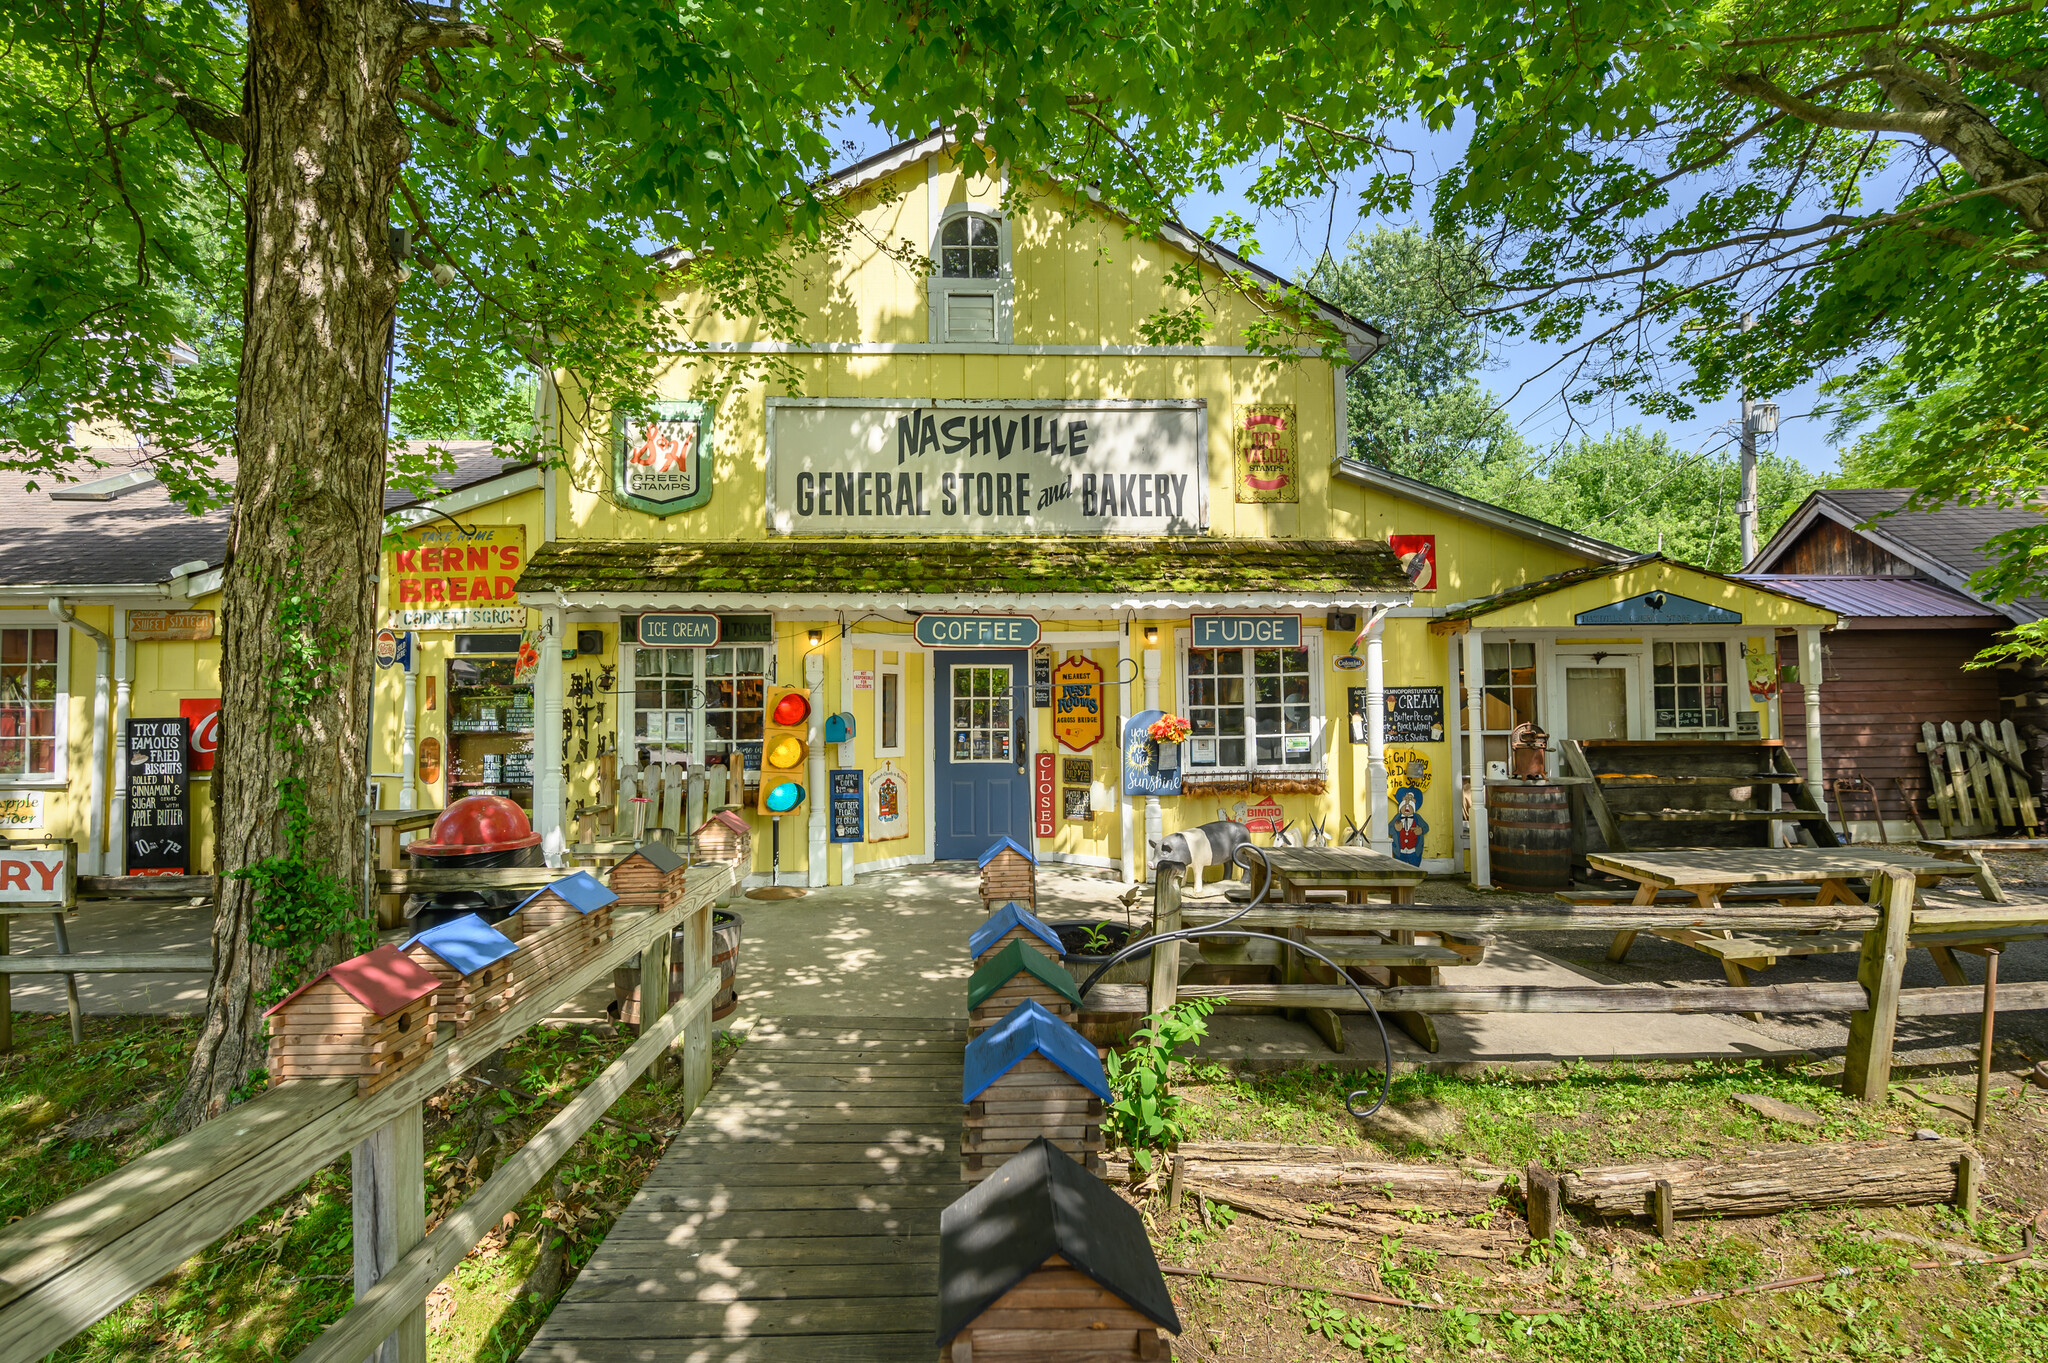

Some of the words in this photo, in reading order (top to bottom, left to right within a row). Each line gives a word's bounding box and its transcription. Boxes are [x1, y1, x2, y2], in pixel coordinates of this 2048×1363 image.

[898, 409, 1090, 466] NASHVILLE
[1252, 432, 1280, 447] TOP
[1243, 448, 1288, 463] VALUE
[632, 474, 690, 482] GREEN
[632, 483, 690, 491] STAMPS
[796, 472, 931, 516] GENERAL
[942, 472, 1030, 516] STORE
[1037, 474, 1072, 511] and
[1082, 473, 1188, 518] BAKERY
[420, 531, 453, 542] TAKE
[457, 530, 495, 541] HOME
[396, 545, 519, 572] KERN'S
[400, 576, 516, 602] BREAD
[136, 619, 166, 630] SWEET
[170, 615, 208, 627] SIXTEEN
[1666, 614, 1690, 622] STORE
[648, 622, 668, 637] ICE
[672, 622, 710, 637] CREAM
[732, 622, 770, 637] THYME
[932, 621, 1022, 640] COFFEE
[1206, 620, 1284, 641] FUDGE
[1062, 684, 1092, 698] REST
[1057, 697, 1098, 714] ROOMS
[1398, 694, 1440, 709] CREAM
[1394, 712, 1413, 722] Butter
[1414, 711, 1433, 721] Pecan
[134, 724, 158, 736] TRY
[162, 724, 181, 736] OUR
[1397, 722, 1411, 732] Black
[132, 737, 179, 750] FAMOUS
[1131, 728, 1148, 745] you
[150, 750, 180, 763] FRIED
[1394, 752, 1406, 763] Gol
[1409, 752, 1429, 770] Dang
[144, 763, 182, 776] BISCUITS
[132, 775, 157, 784] ROLLED
[164, 775, 174, 784] IN
[1128, 771, 1182, 792] Sunshine
[1390, 778, 1402, 787] the
[132, 785, 170, 796] CINNAMON
[174, 785, 182, 795] &
[1040, 756, 1053, 835] CLOSED
[0, 792, 39, 812] pple
[132, 798, 156, 809] SUGAR
[131, 809, 152, 826] APPLE
[157, 809, 183, 826] BUTTER
[1247, 808, 1281, 817] BIMBO
[135, 839, 150, 856] 10
